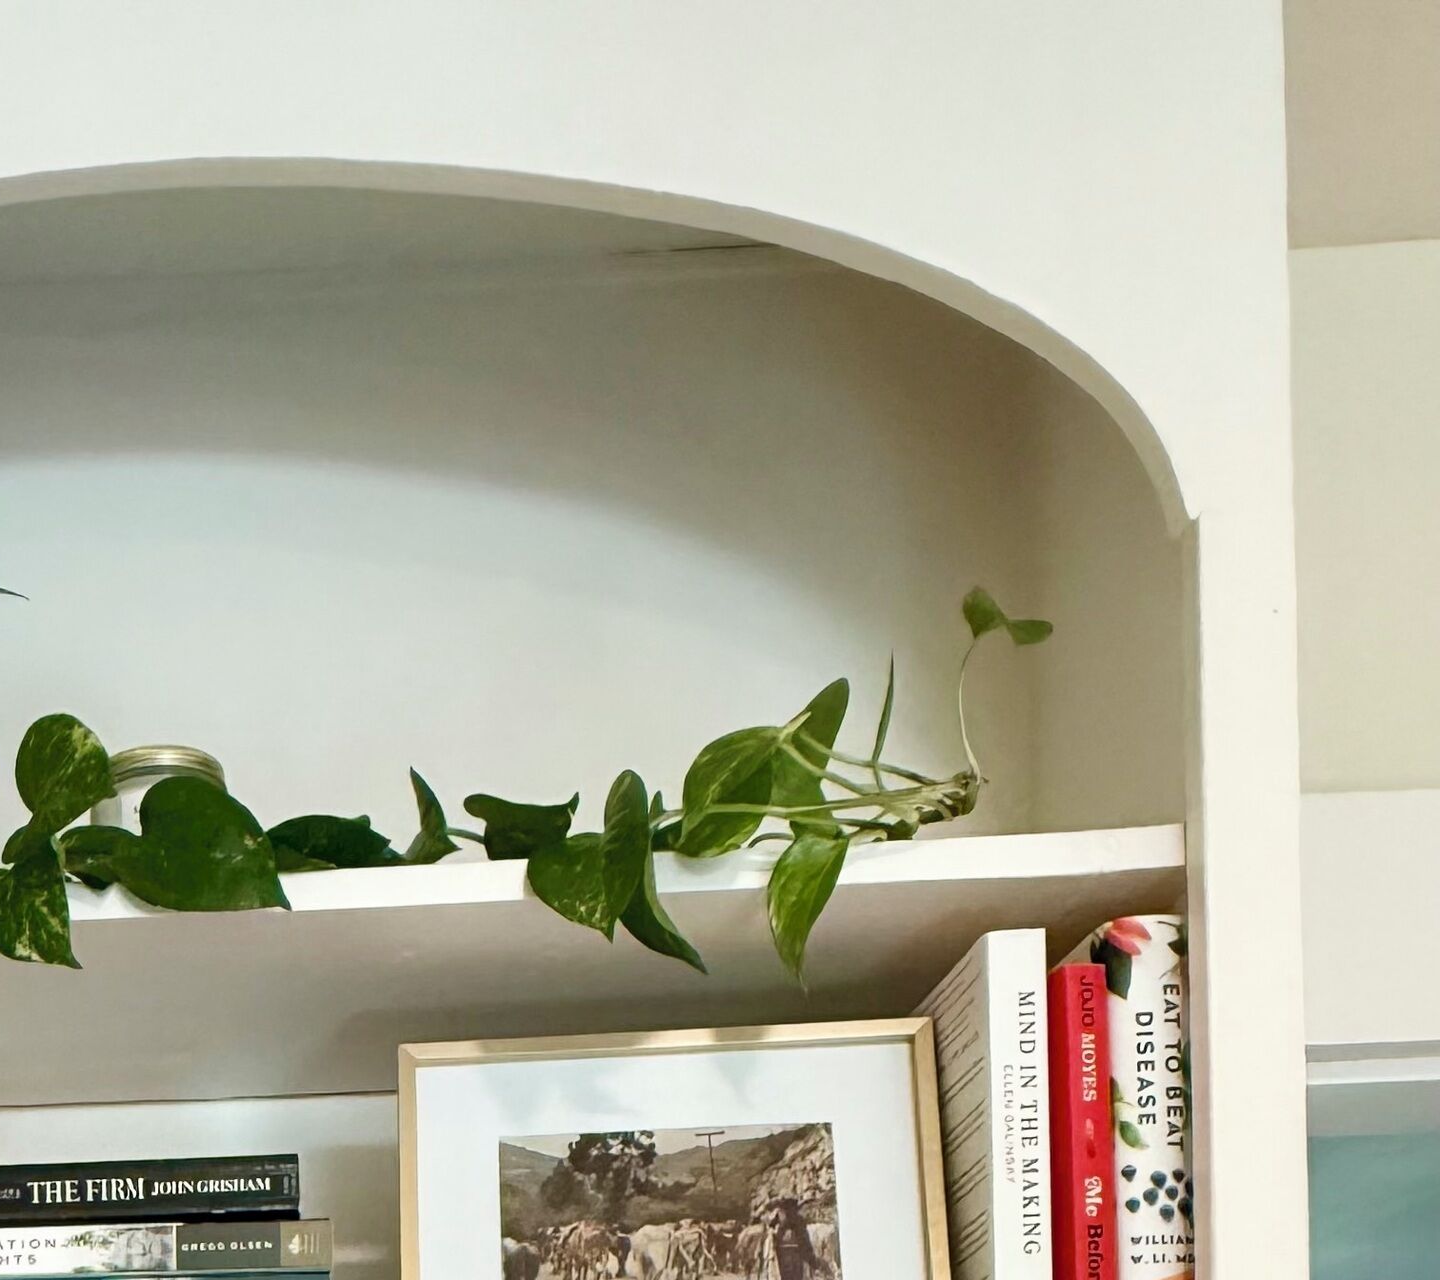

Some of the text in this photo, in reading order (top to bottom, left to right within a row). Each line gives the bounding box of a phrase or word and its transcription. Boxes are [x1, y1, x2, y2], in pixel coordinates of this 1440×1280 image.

[1079, 975, 1097, 1102] JOJO MOYES
[1135, 1012, 1156, 1126] DISEASE
[1162, 984, 1184, 1150] EAT TO BEAT
[1018, 991, 1041, 1256] MIND IN THE MAKING
[27, 1180, 80, 1205] THE
[86, 1177, 144, 1201] FIRM
[152, 1179, 195, 1195] JOHN
[197, 1177, 271, 1194] GRISHAM
[230, 1241, 272, 1249] OLSEN
[1083, 1176, 1103, 1216] Me
